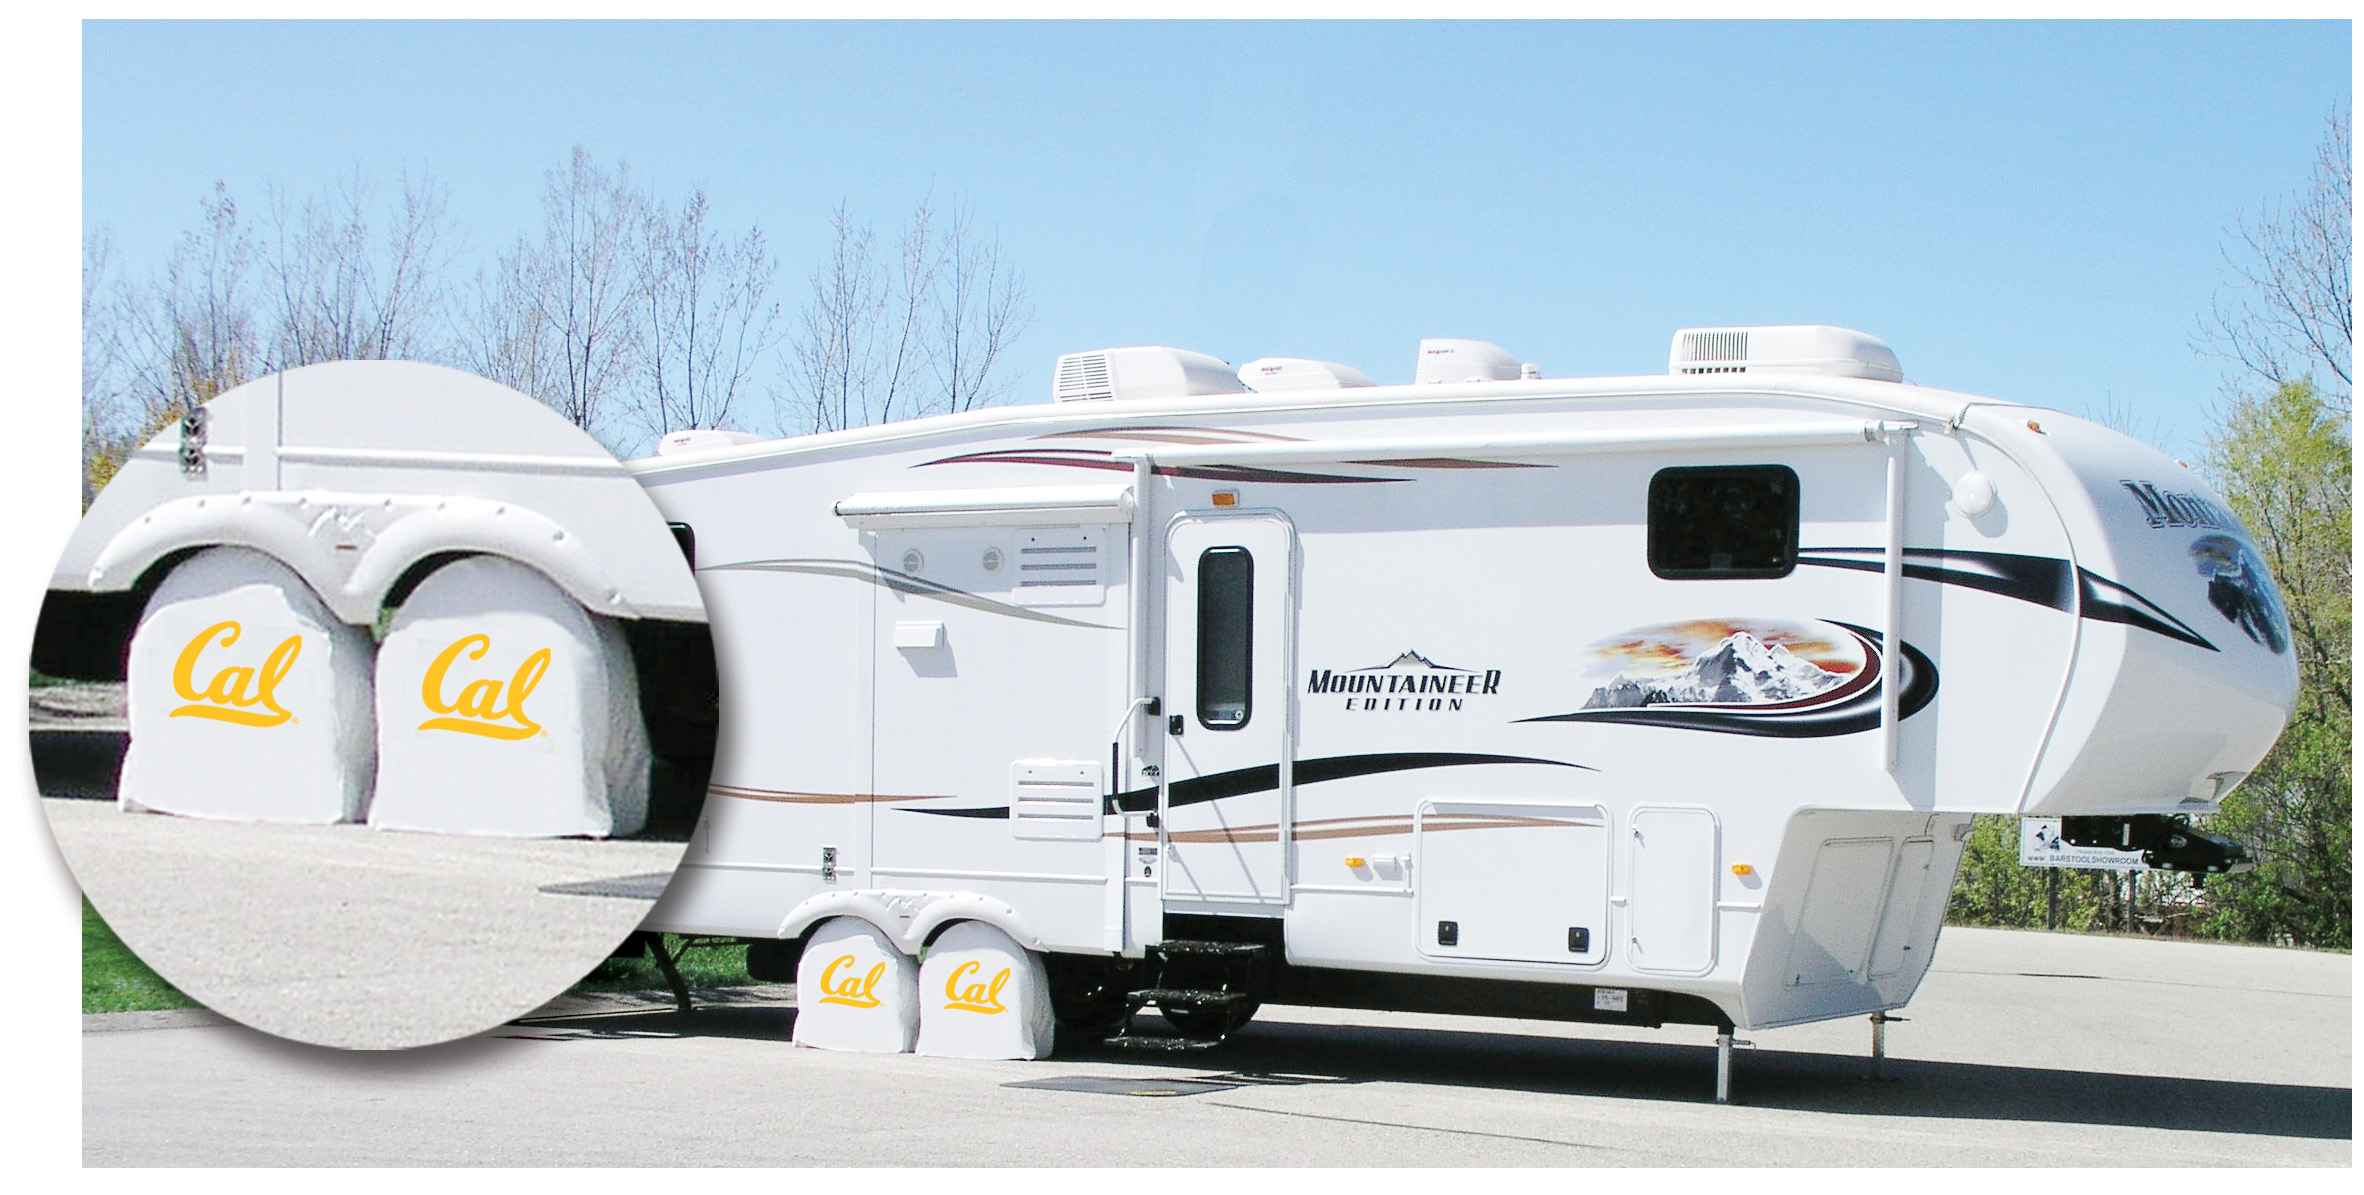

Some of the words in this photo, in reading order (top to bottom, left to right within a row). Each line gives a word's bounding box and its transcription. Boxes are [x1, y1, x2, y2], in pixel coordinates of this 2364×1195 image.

[169, 620, 303, 728] Cal
[417, 633, 552, 741] Cal
[1307, 669, 1502, 695] MOUNTAINEER
[1345, 698, 1463, 712] EDITION
[818, 954, 886, 1009] Cal
[943, 960, 1011, 1015] Cal
